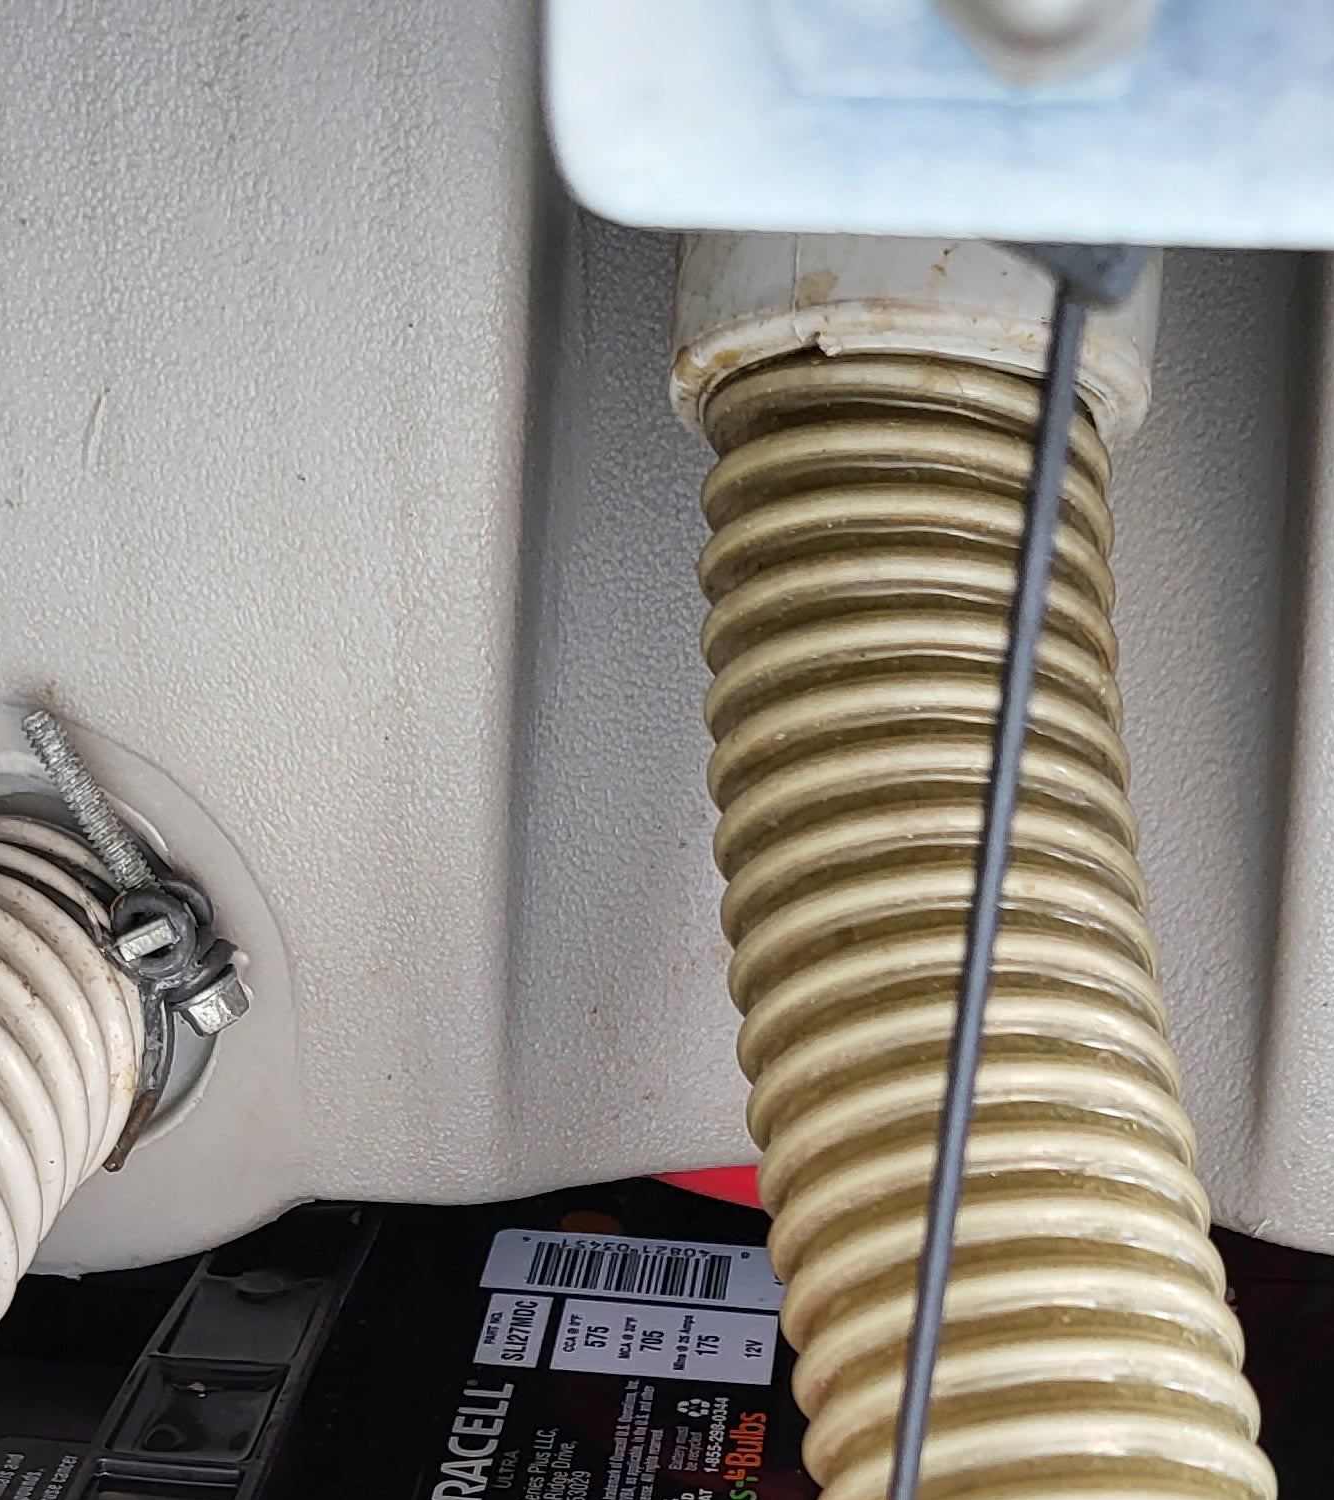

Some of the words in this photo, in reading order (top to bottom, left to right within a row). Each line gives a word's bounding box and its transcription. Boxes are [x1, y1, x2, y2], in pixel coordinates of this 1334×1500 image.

[501, 1300, 538, 1362] SLI27MDC
[584, 1325, 610, 1348] 575
[640, 1329, 665, 1352] 705
[695, 1334, 720, 1357] 175
[743, 1338, 764, 1359] 12V
[534, 1427, 559, 1450] LLC,
[527, 1452, 549, 1474] Plus
[551, 1440, 579, 1470] Drive,
[492, 1450, 520, 1489] ULTRA
[543, 1470, 570, 1500] Ridge
